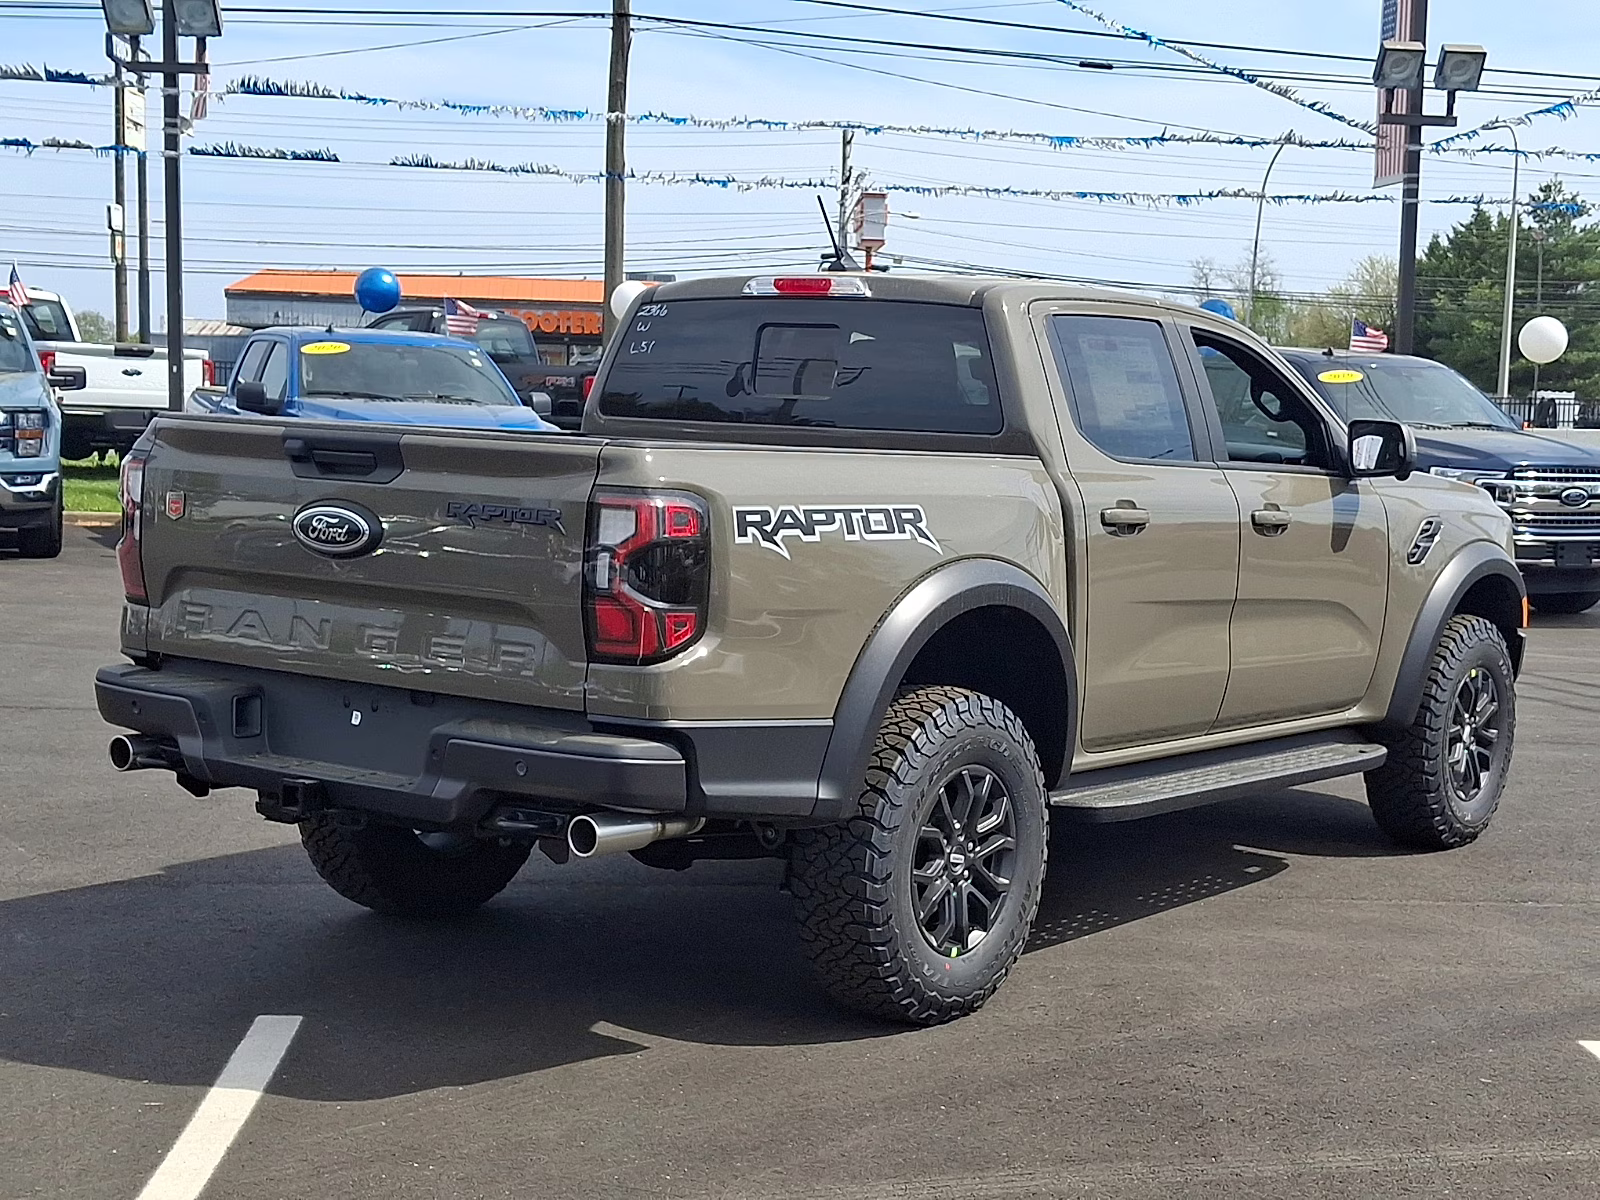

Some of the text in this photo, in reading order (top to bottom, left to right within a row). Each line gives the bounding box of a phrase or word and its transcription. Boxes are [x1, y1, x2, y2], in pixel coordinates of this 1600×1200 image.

[504, 308, 604, 335] OOTER
[307, 514, 349, 543] Ford
[446, 501, 567, 536] RAPTOR
[733, 504, 943, 561] RAPTOR
[177, 599, 536, 677] RANGER
